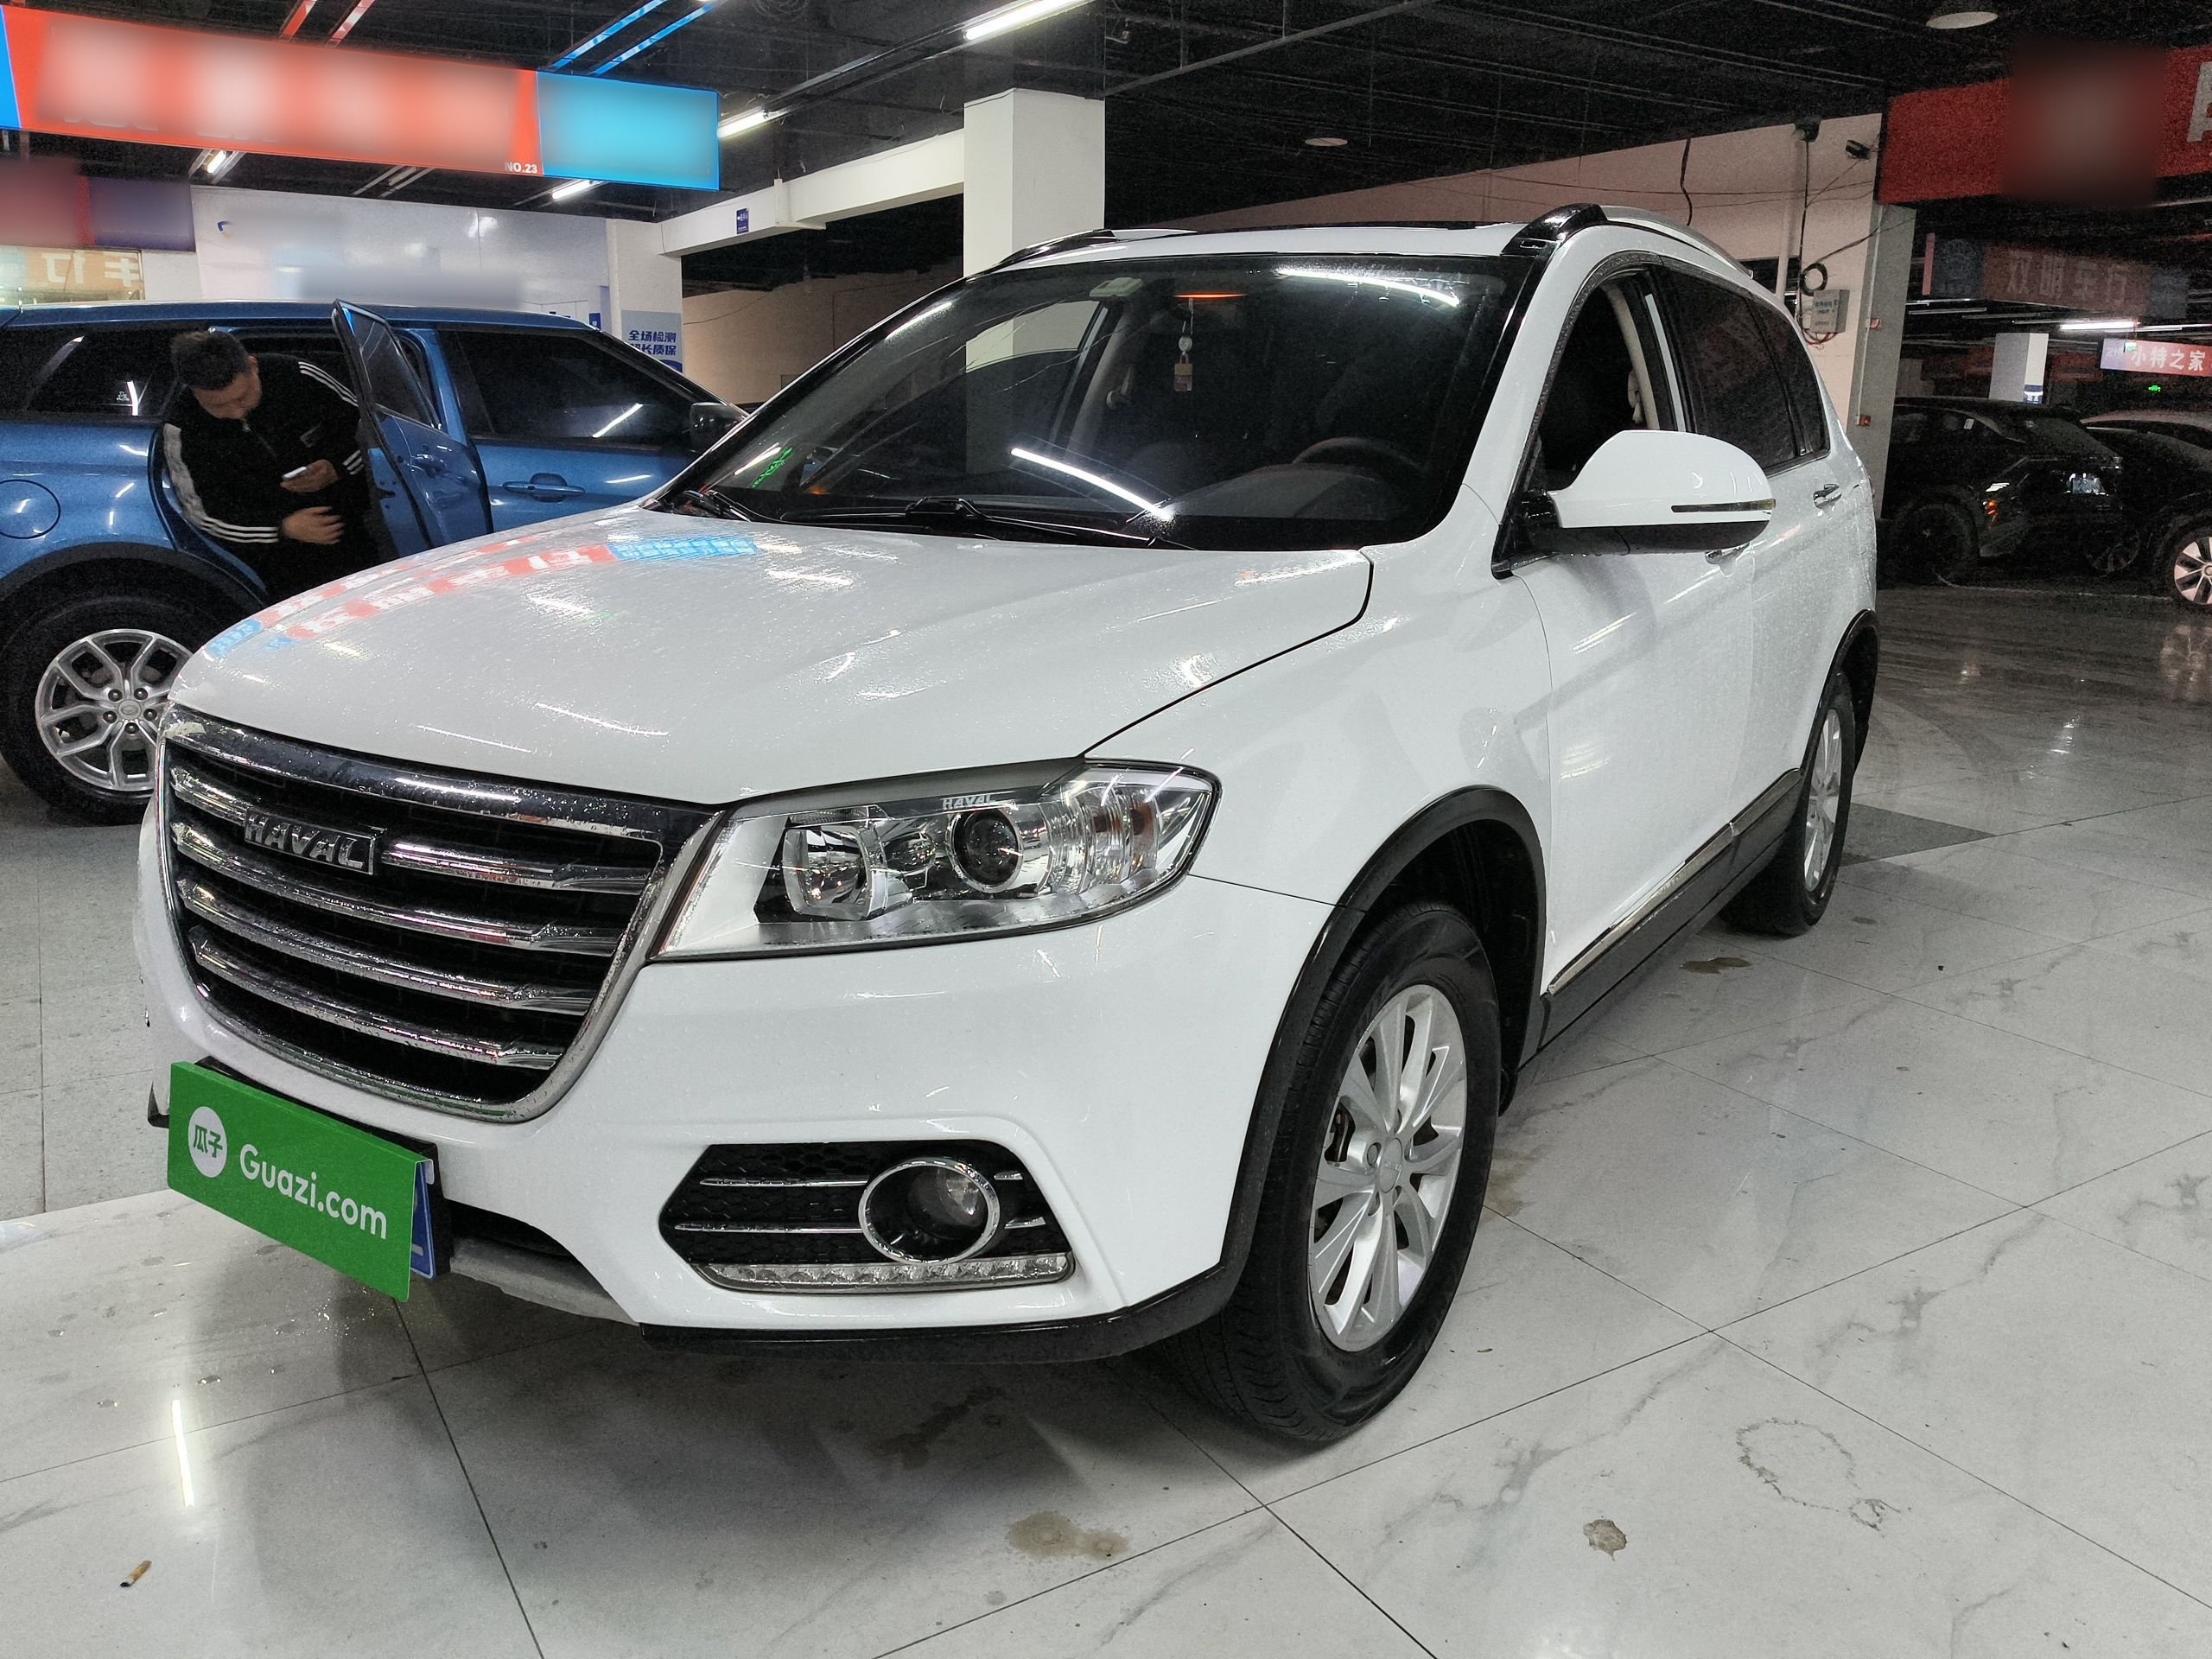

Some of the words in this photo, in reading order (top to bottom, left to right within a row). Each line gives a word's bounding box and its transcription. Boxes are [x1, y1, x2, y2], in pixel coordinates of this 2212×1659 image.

[505, 162, 537, 174] NO.23
[628, 330, 677, 343] 全场检测
[943, 795, 996, 810] HAVAL
[245, 814, 364, 869] HAVAL
[193, 1124, 223, 1159] 瓜子
[240, 1143, 387, 1240] Guazi.com
